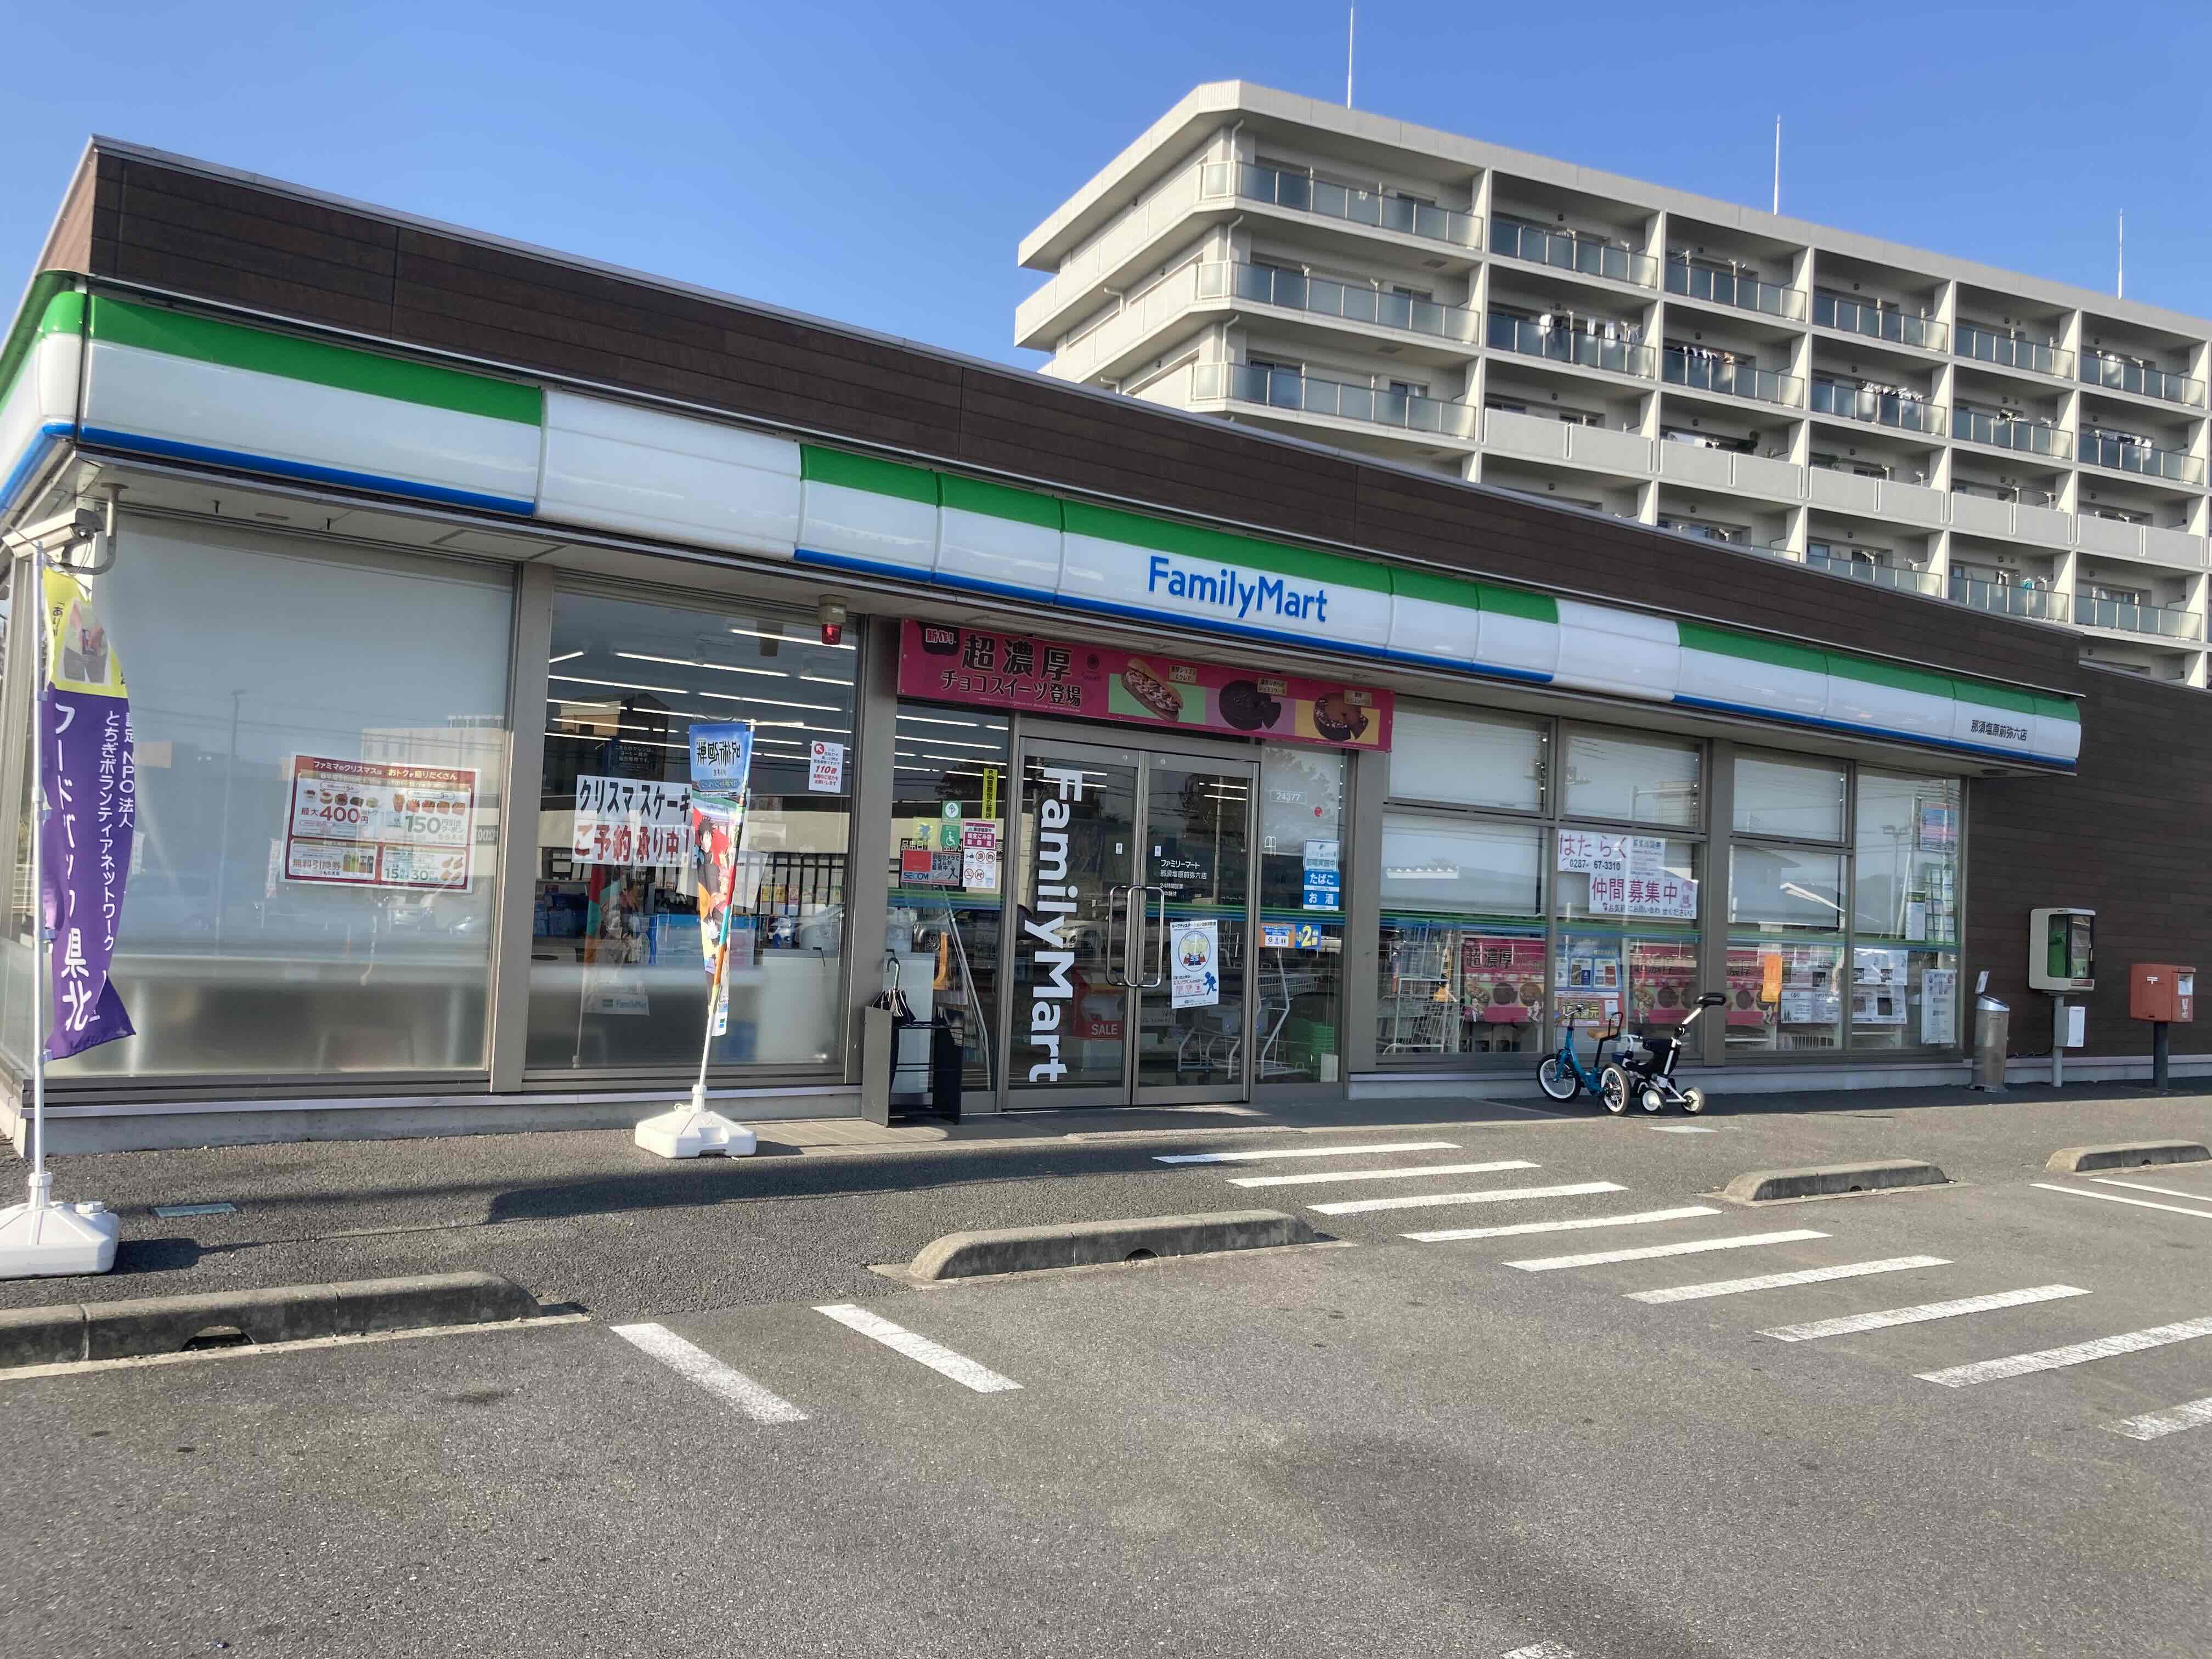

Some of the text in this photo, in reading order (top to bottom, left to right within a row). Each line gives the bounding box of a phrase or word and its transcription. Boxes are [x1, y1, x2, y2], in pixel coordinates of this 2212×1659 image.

[1148, 555, 1327, 623] FamilyMart
[961, 633, 1074, 682] 超濃厚
[940, 668, 1082, 708] チョコスイーツ登場
[1971, 719, 2028, 741] 那須塩原前弥六店
[118, 797, 134, 828] 法人
[579, 779, 691, 822] クリスマスケーキ
[97, 710, 120, 952] とちぎボランティアネットワーク
[1560, 833, 1626, 859] はたらく
[1160, 859, 1200, 870] ファミリーマート
[1160, 870, 1207, 879] 那須塩原前弥六店
[1310, 872, 1334, 885] たばこ
[1593, 860, 1621, 871] 67-3310
[1592, 876, 1678, 905] 仲間募集中
[1024, 767, 1082, 1083] FamilyMart
[1091, 1023, 1118, 1036] SALE
